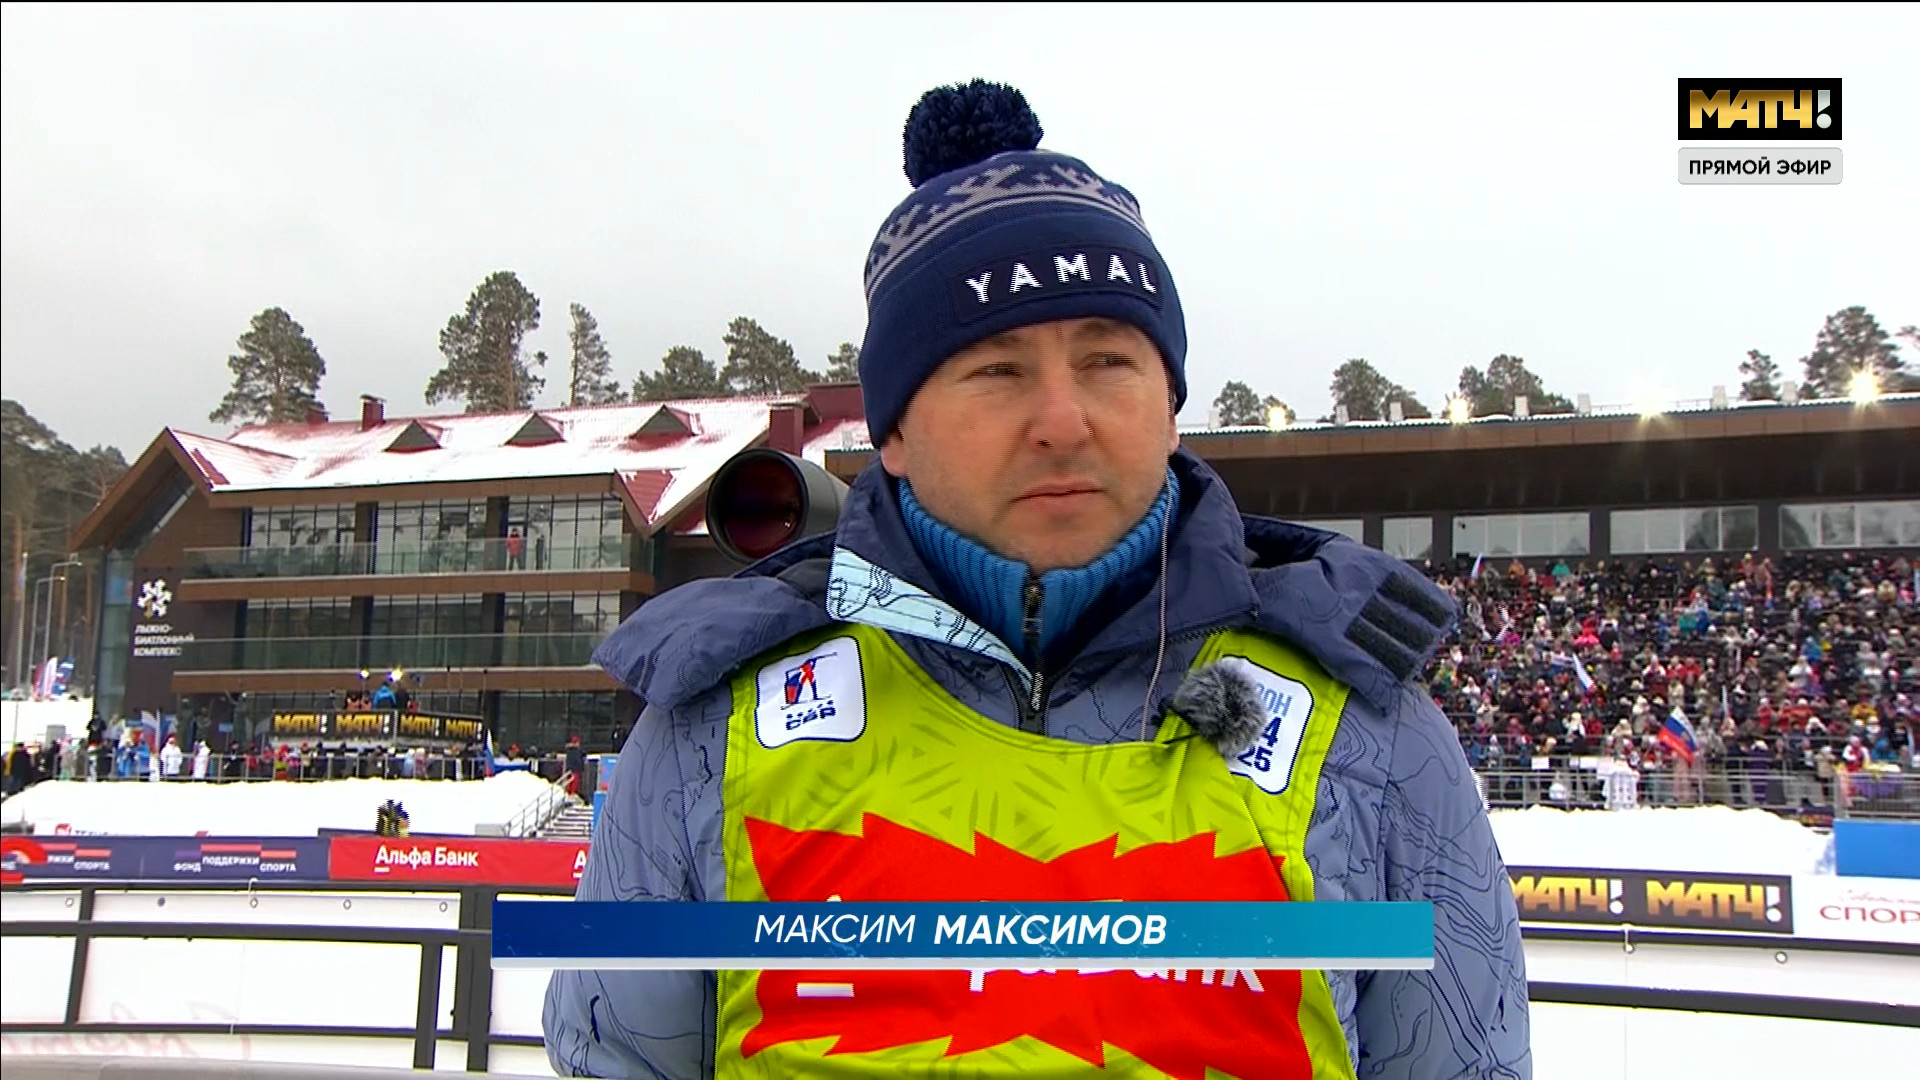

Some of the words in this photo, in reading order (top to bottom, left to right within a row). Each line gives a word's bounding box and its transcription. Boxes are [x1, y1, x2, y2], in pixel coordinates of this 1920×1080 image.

[965, 253, 1157, 303] YAMAL
[174, 862, 202, 872] ФОНД
[202, 855, 260, 866] ПОДДЕРЖКИ
[260, 864, 297, 872] СПОРТА
[375, 845, 431, 870] Альфа
[434, 847, 479, 866] Банк
[1646, 880, 1782, 922] МАТЧ!
